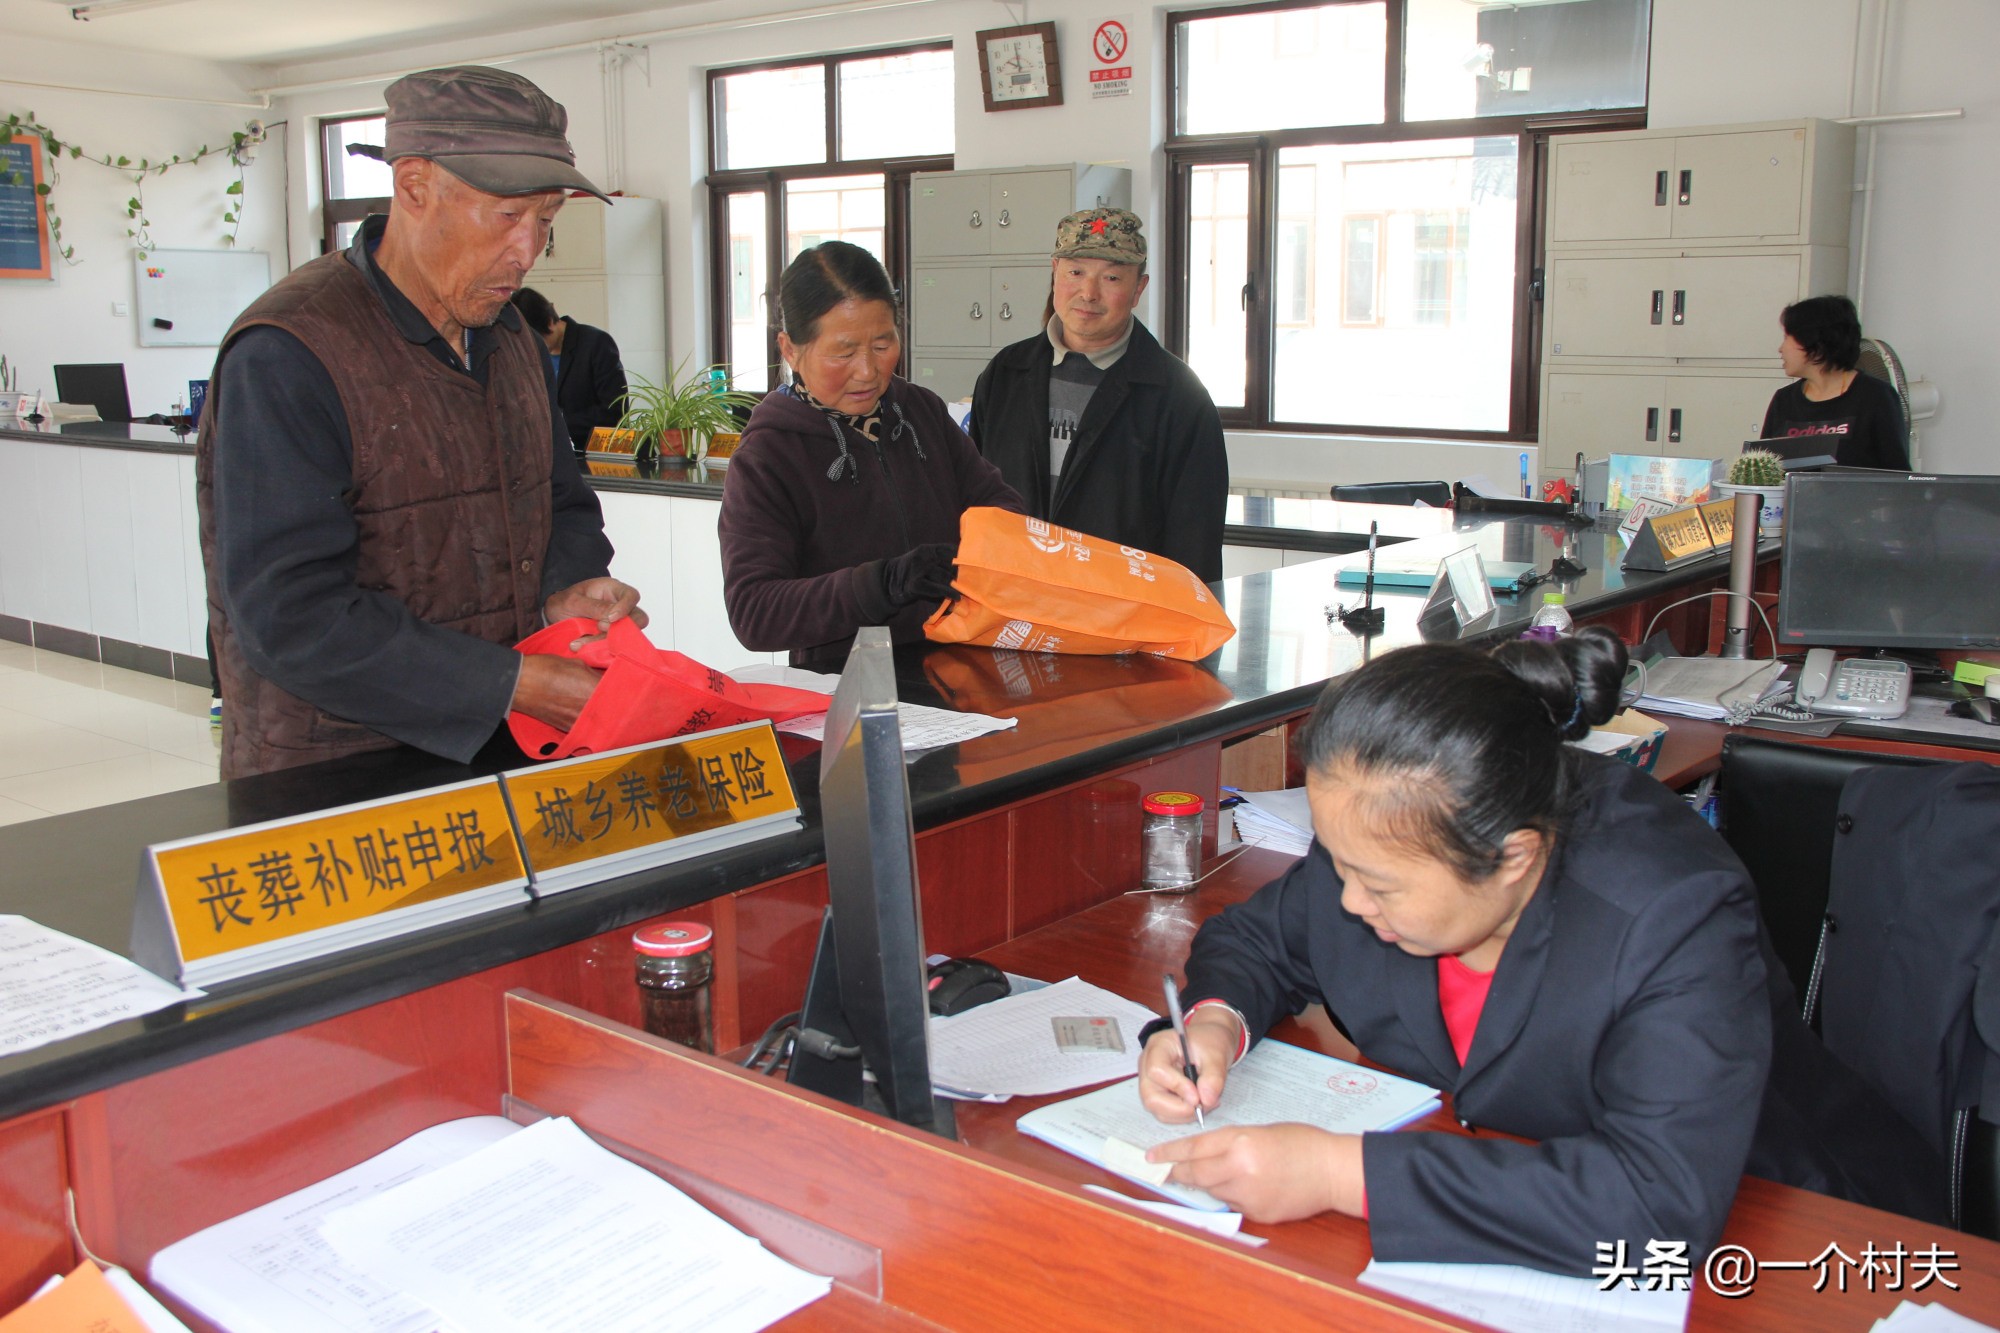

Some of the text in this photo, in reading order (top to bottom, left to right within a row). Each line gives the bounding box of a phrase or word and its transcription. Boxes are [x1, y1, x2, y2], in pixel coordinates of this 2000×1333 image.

[1103, 80, 1128, 88] SMOKING
[535, 747, 774, 848] 城乡养老保险
[197, 809, 494, 932] 丧葬补贴申报
